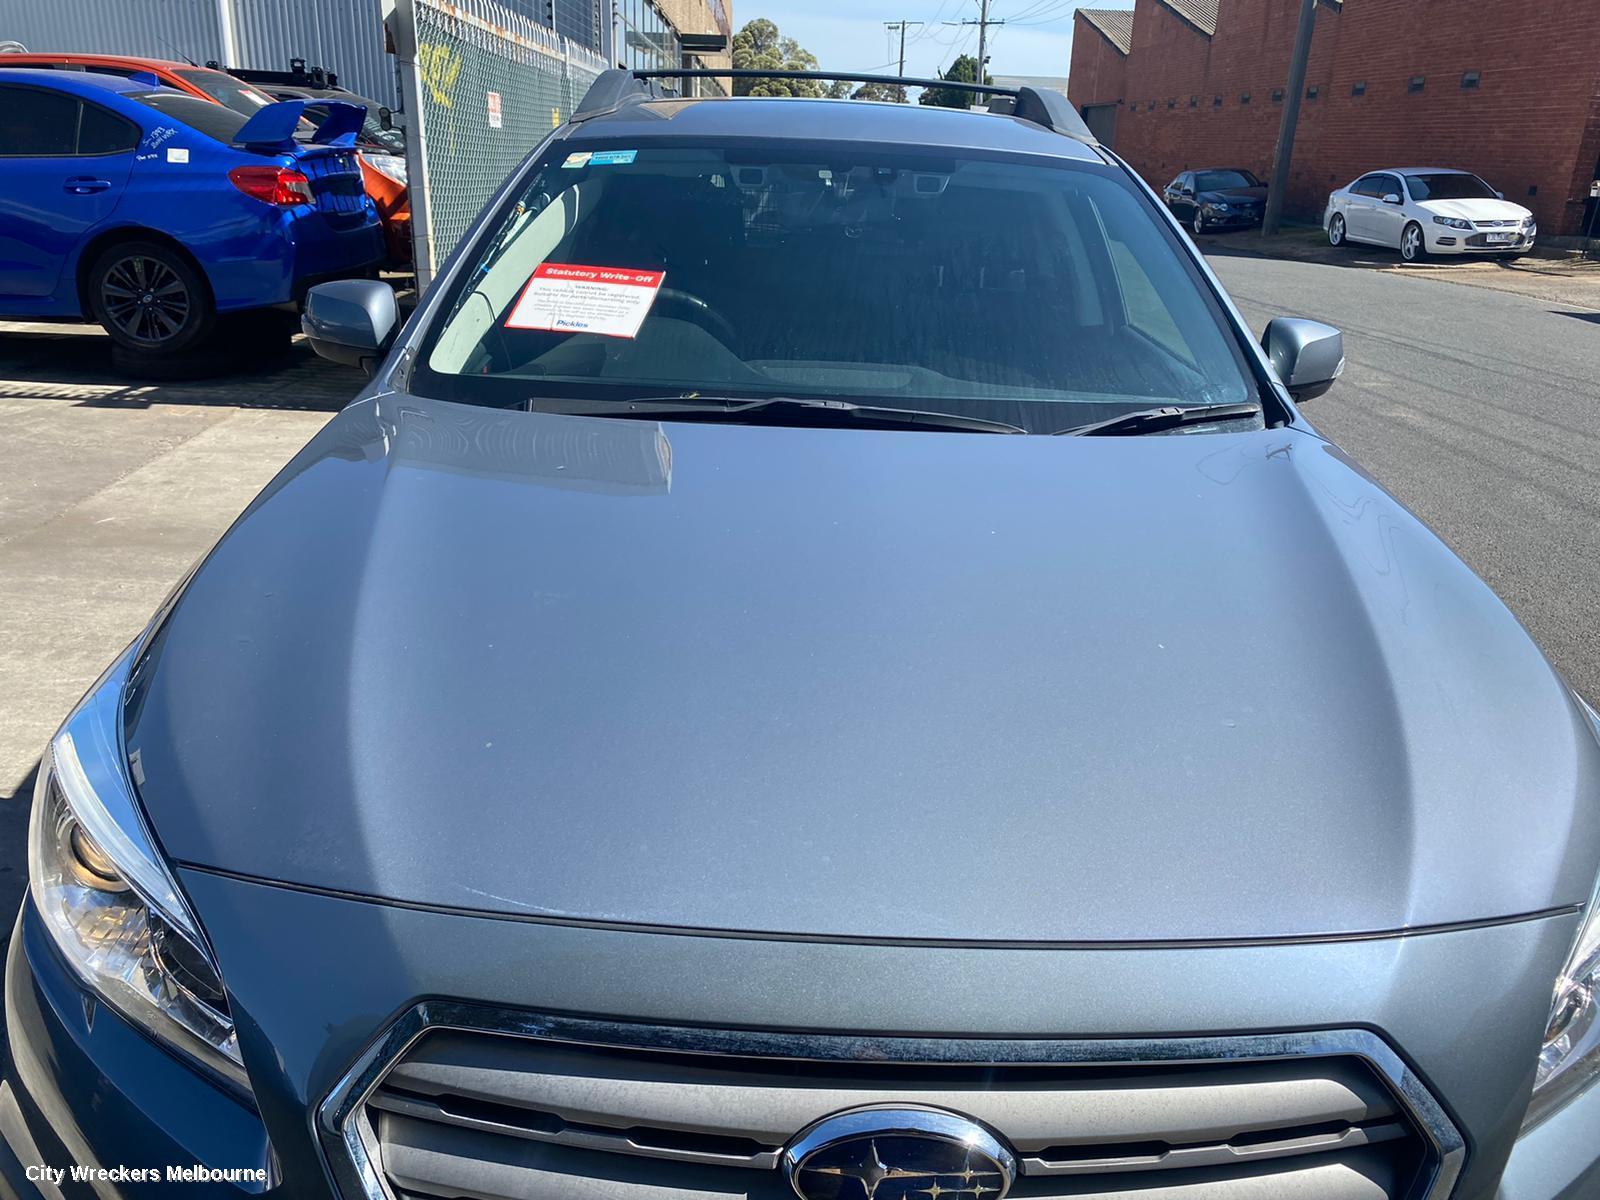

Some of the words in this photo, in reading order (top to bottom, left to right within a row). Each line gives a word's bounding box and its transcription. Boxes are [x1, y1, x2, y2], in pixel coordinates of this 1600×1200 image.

[545, 267, 598, 279] Statutory
[600, 271, 655, 283] Write-Off
[556, 319, 589, 328] Pickles
